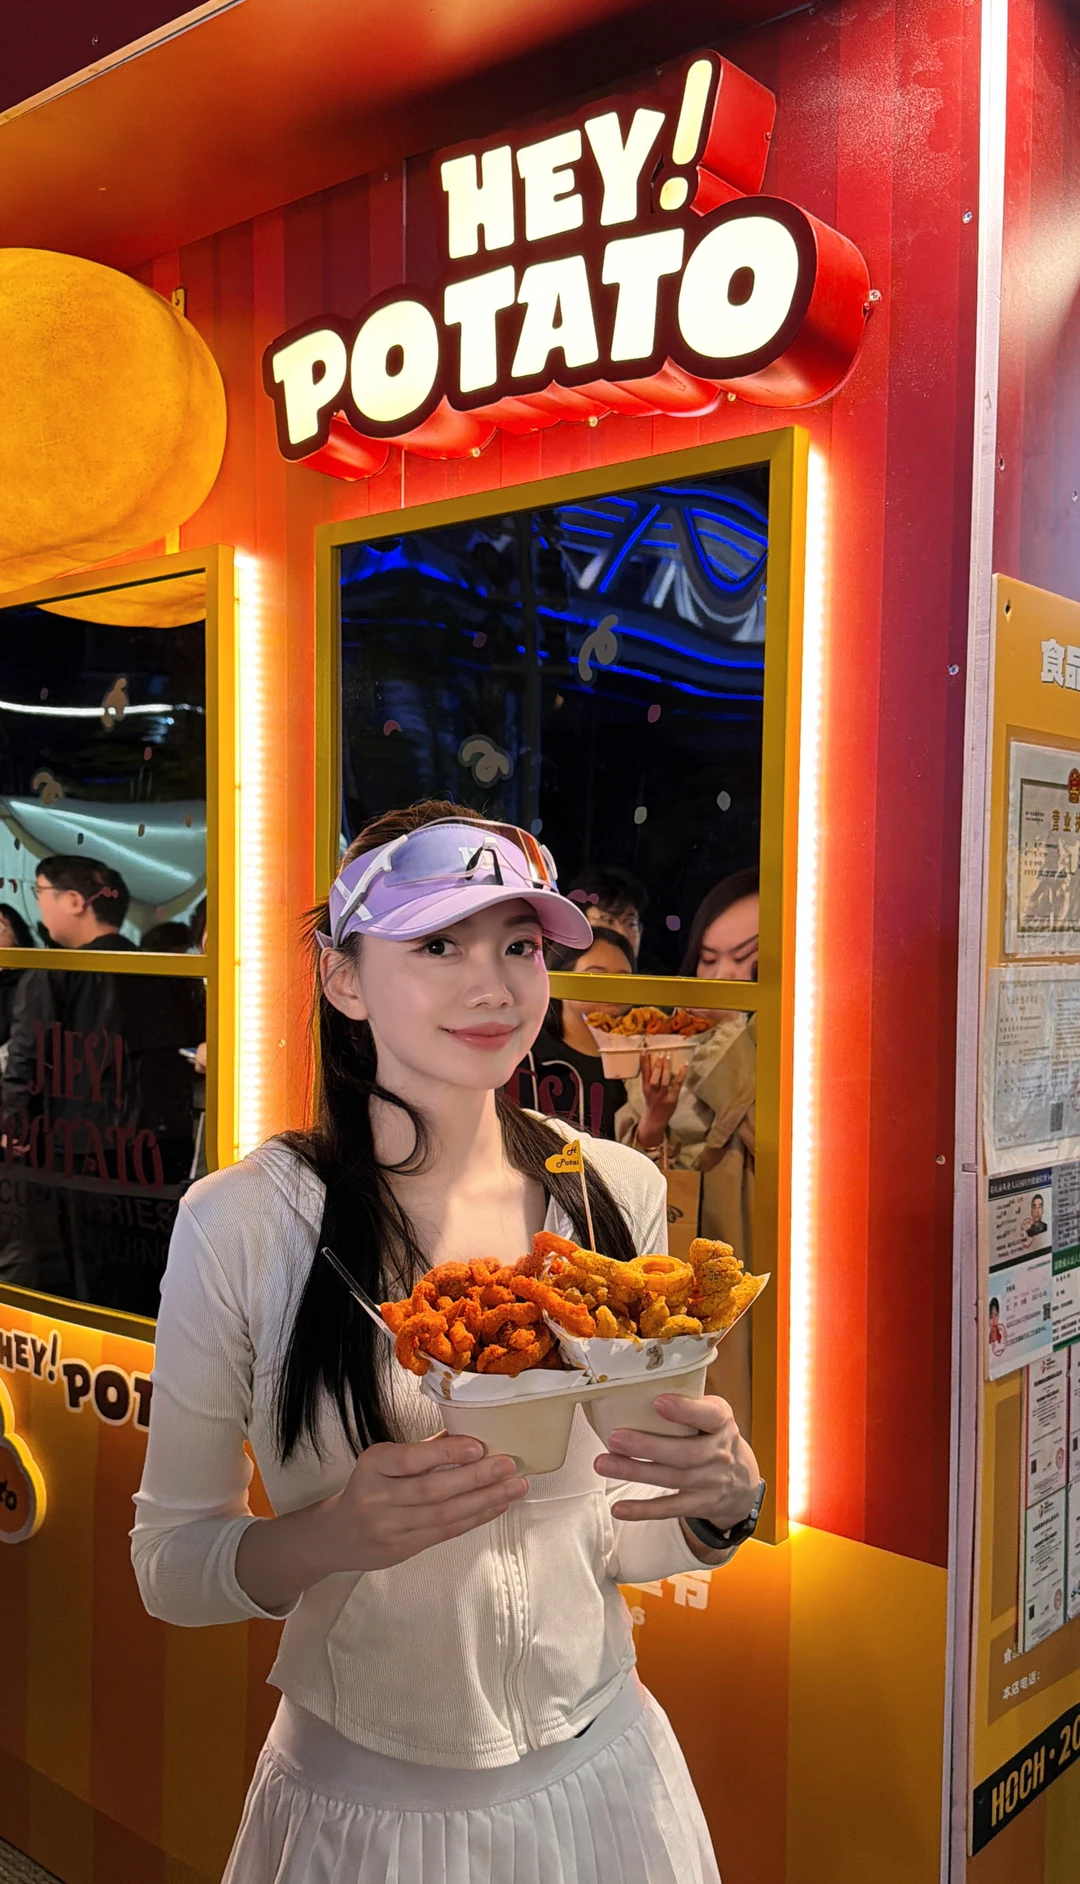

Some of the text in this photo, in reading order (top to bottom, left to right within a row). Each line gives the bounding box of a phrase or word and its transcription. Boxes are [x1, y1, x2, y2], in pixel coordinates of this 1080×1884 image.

[440, 59, 713, 260] HEY!
[271, 215, 800, 446] POTATO
[28, 1020, 124, 1109] HEY!
